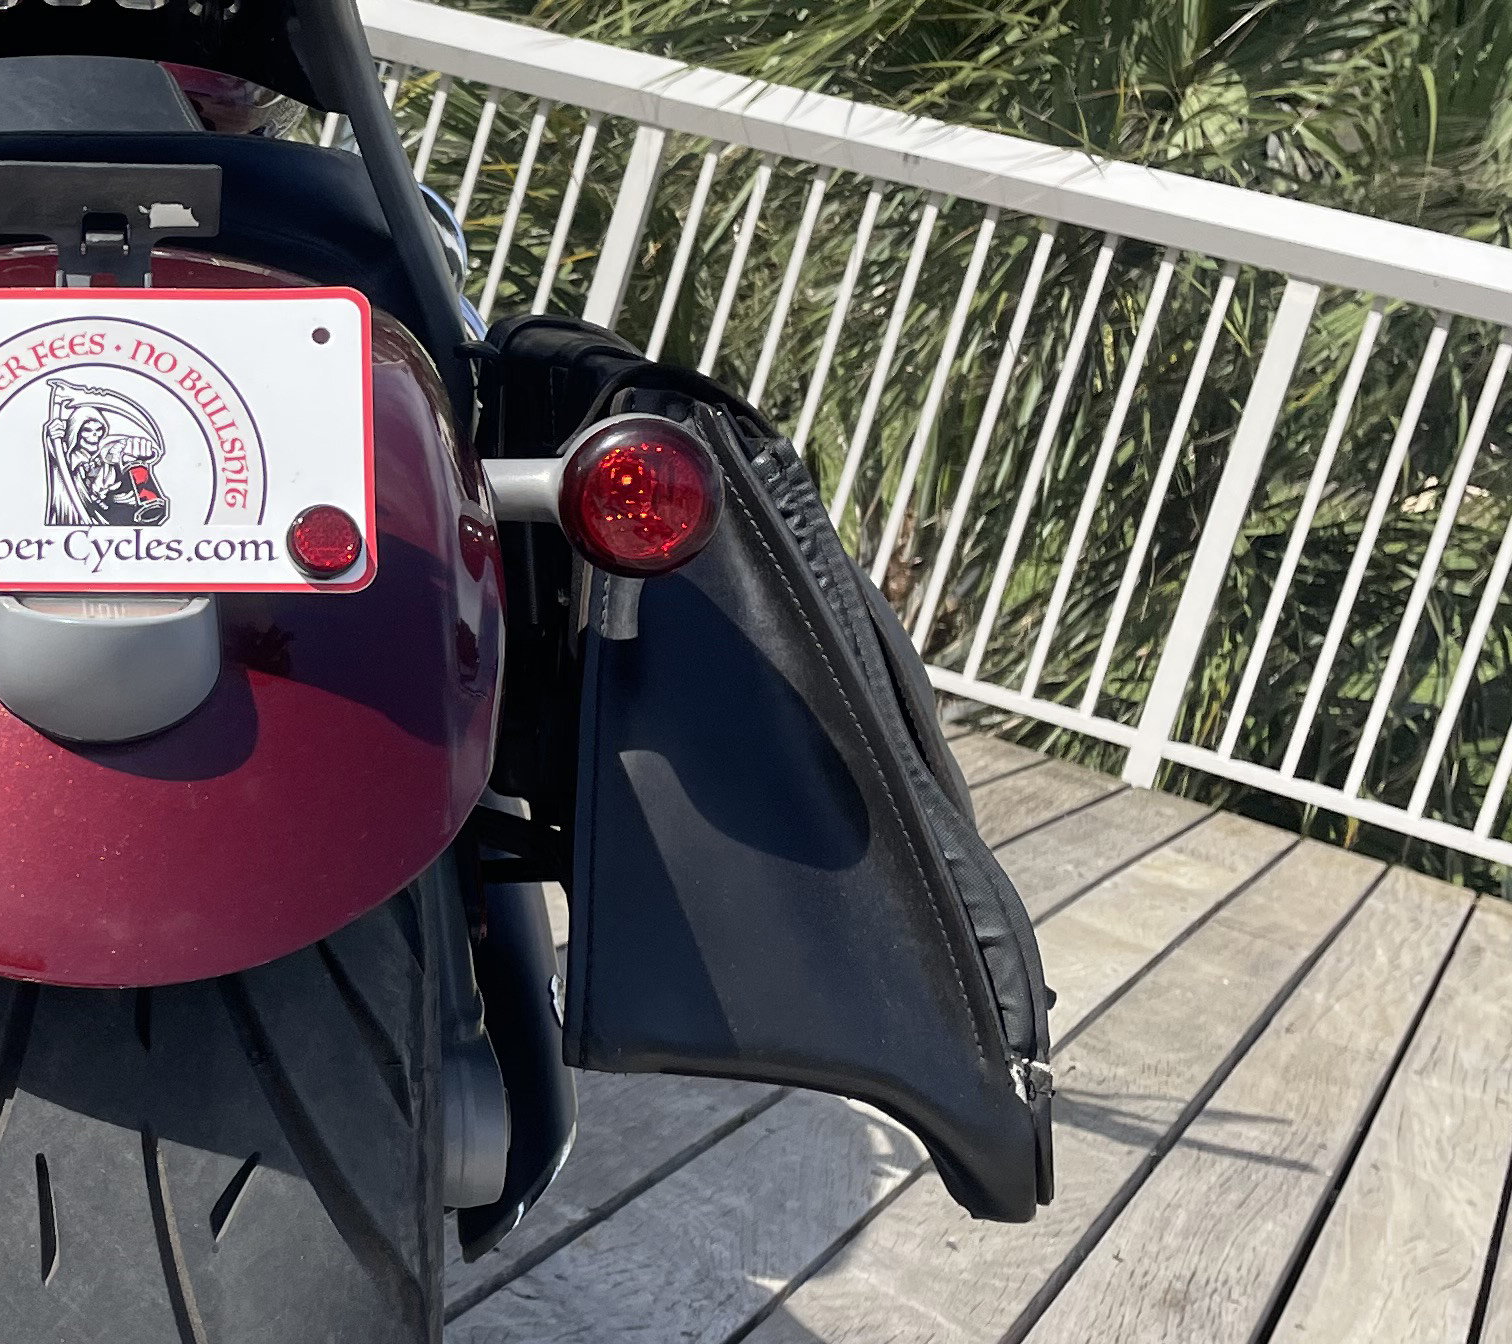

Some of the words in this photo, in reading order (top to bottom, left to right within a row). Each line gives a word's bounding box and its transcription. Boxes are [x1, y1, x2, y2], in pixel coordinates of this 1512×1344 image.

[27, 332, 106, 370] FEES
[128, 339, 178, 374] NO
[176, 366, 249, 509] BULLSHIT
[63, 527, 278, 573] Cycles.com
